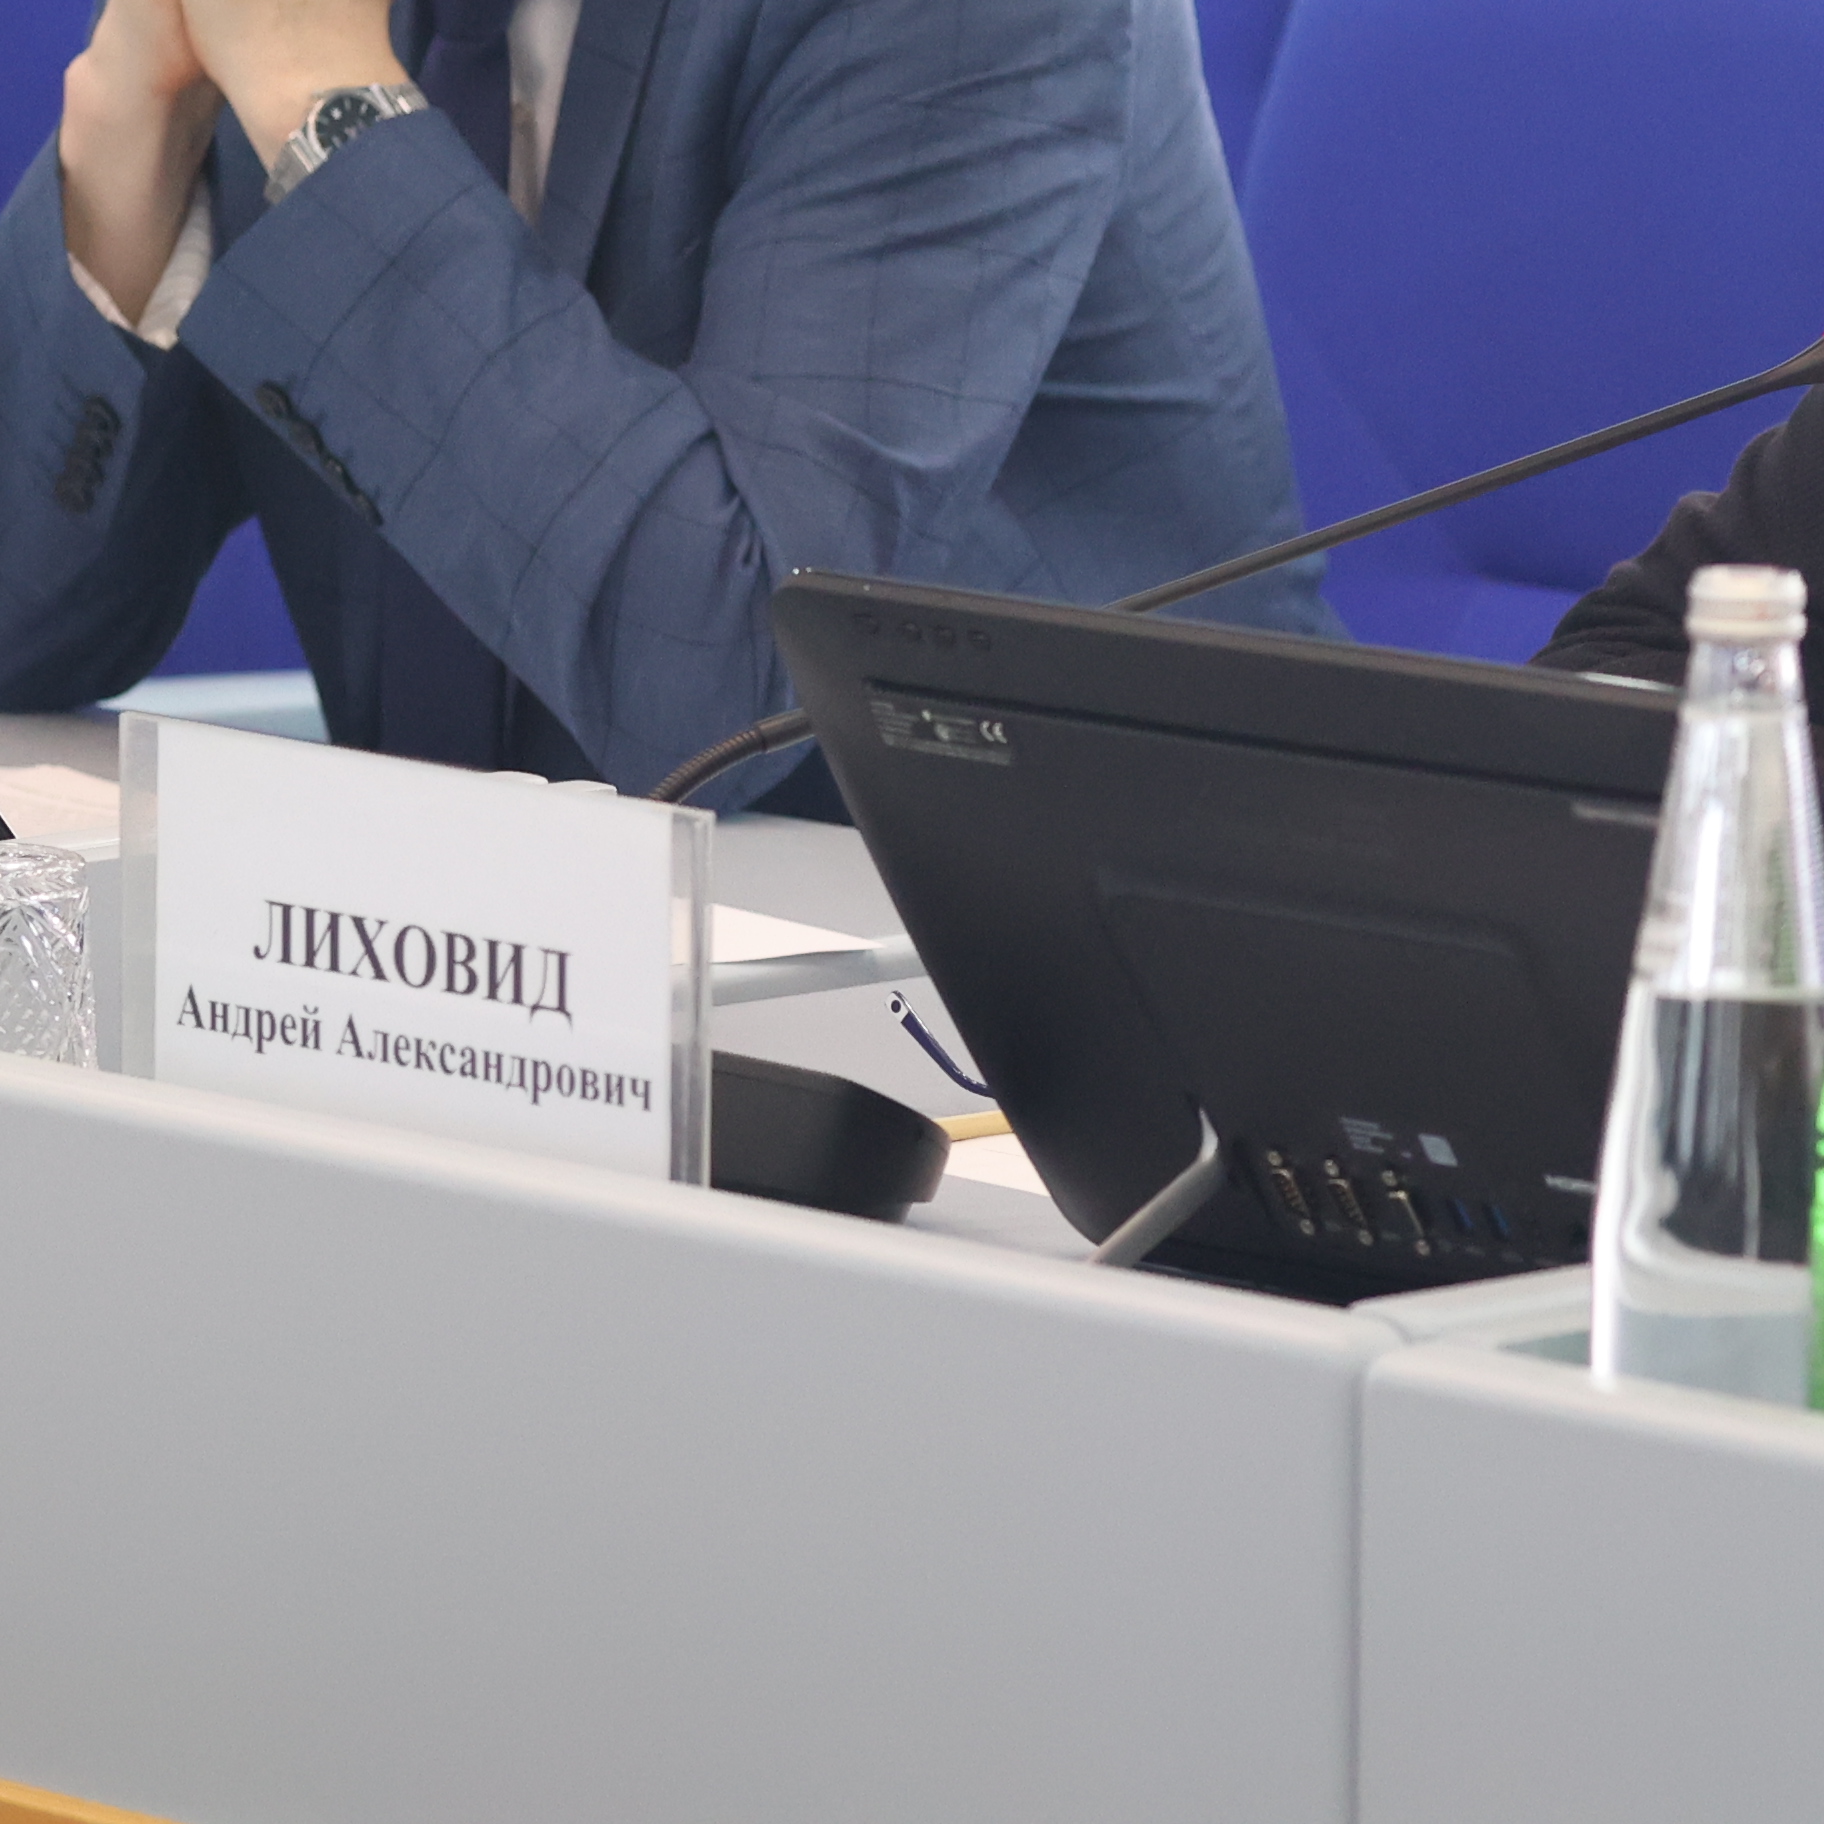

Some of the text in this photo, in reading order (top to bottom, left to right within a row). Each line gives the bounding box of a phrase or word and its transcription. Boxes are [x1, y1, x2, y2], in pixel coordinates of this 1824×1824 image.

[253, 899, 573, 1027] ЛИХОВИД
[177, 986, 652, 1111] Андрей Александрович
